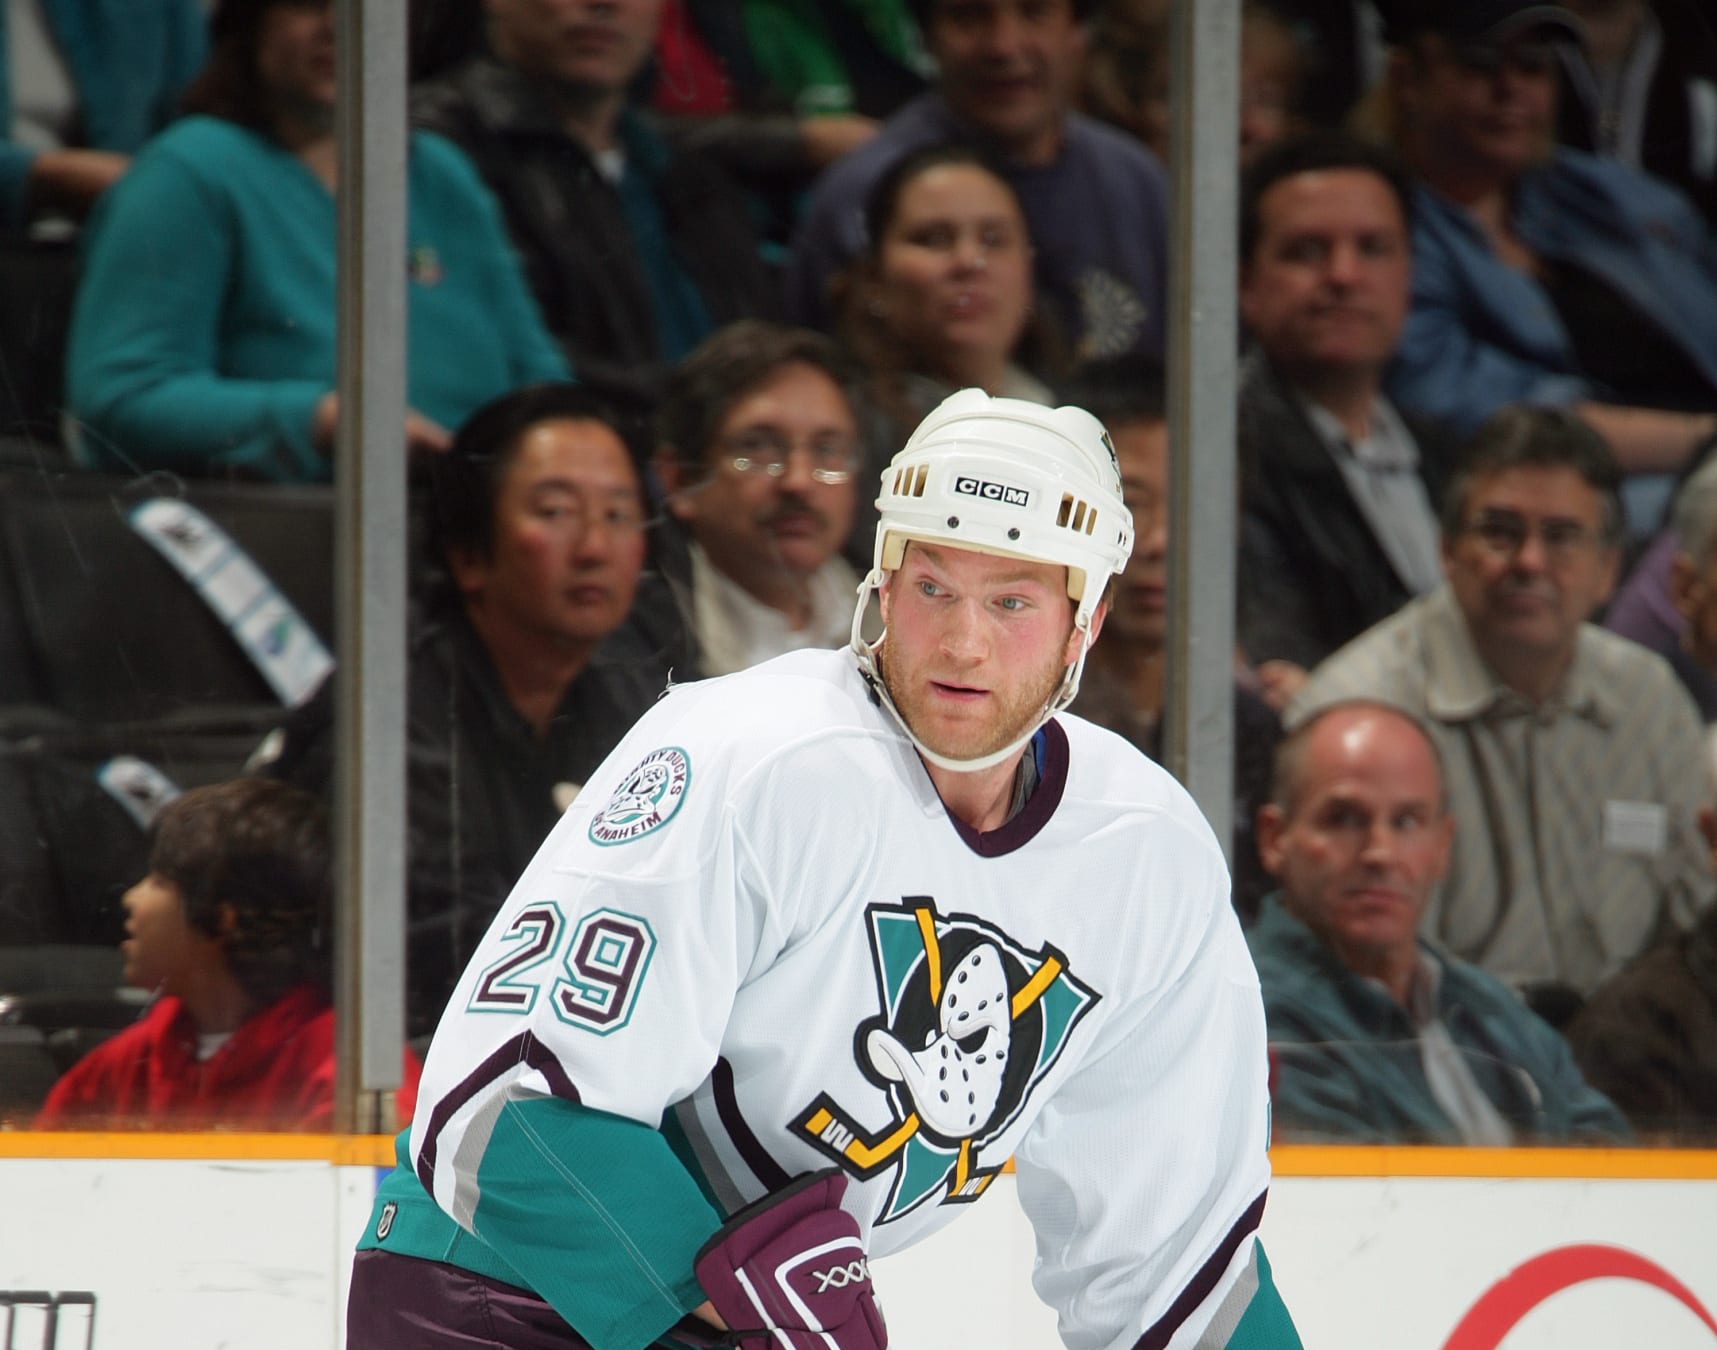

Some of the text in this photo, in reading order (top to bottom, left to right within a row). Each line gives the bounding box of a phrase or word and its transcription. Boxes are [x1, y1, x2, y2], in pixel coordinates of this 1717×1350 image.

[956, 477, 1028, 506] CCM
[666, 751, 685, 796] DUCKS
[594, 811, 662, 841] ANAHEIM
[465, 900, 657, 1037] 29
